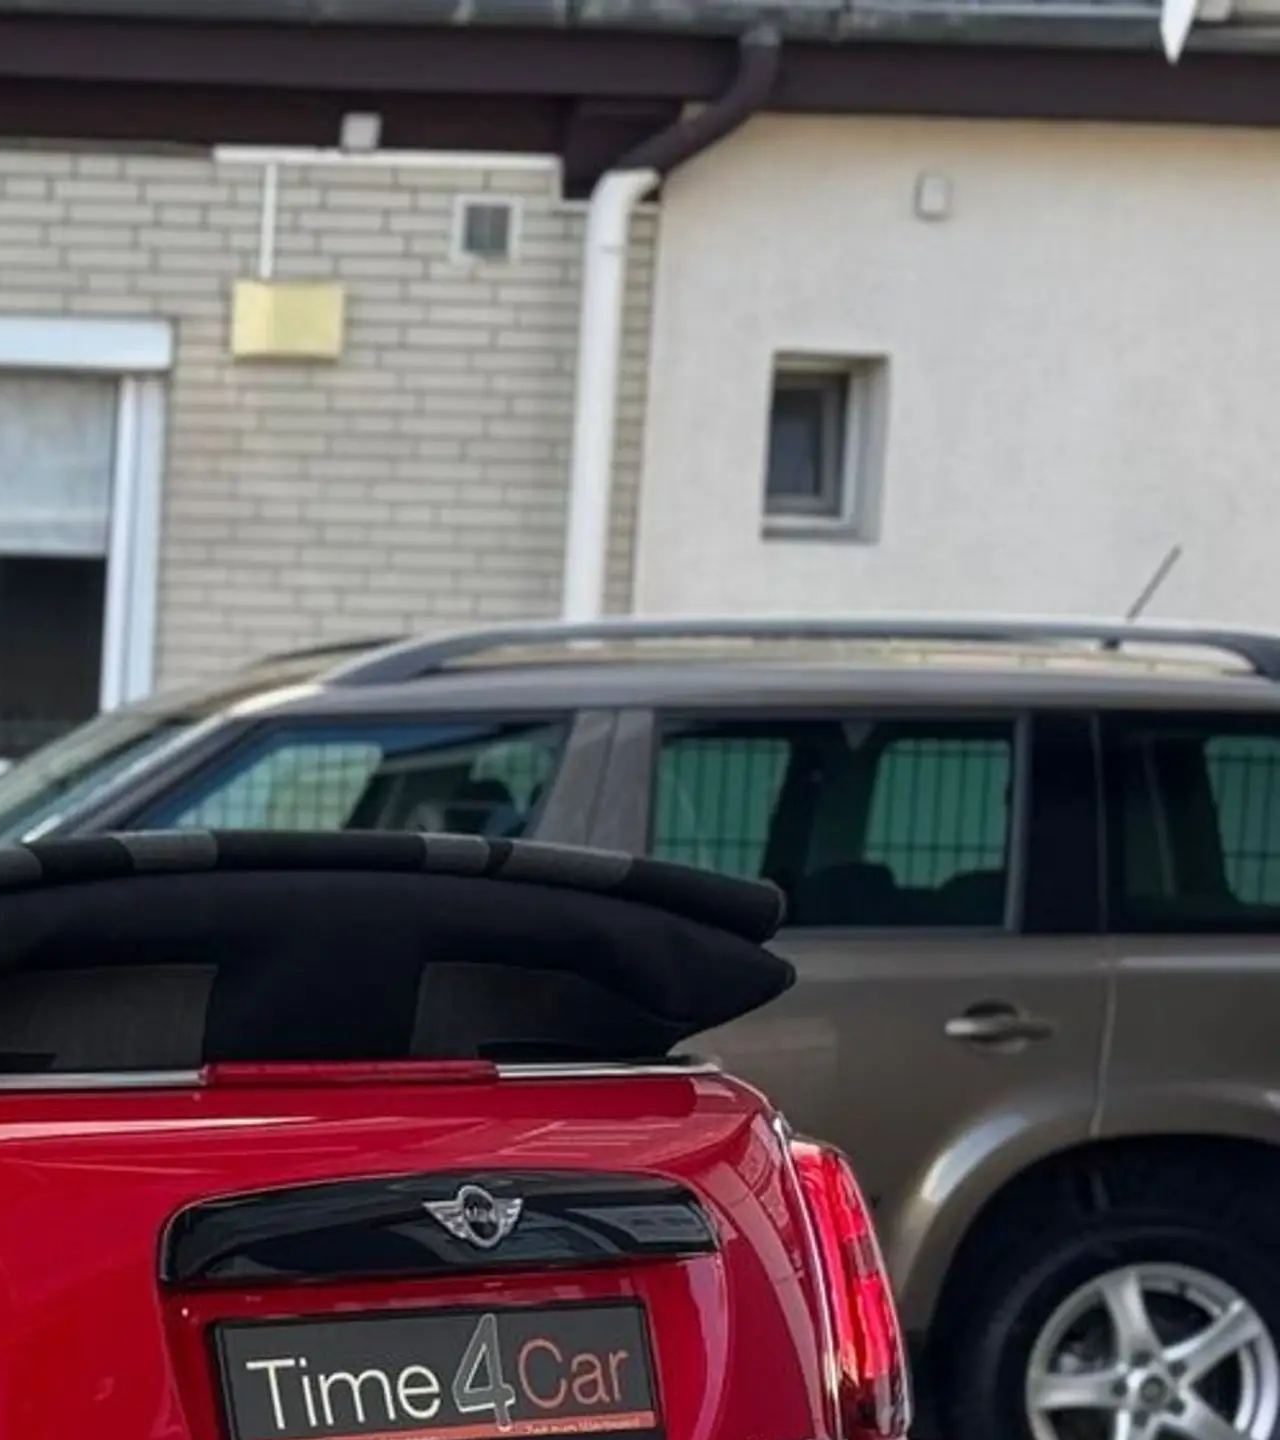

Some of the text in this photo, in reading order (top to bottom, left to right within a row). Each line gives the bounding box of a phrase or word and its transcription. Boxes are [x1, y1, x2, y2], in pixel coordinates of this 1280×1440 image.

[245, 1313, 630, 1431] Time 4 Car
